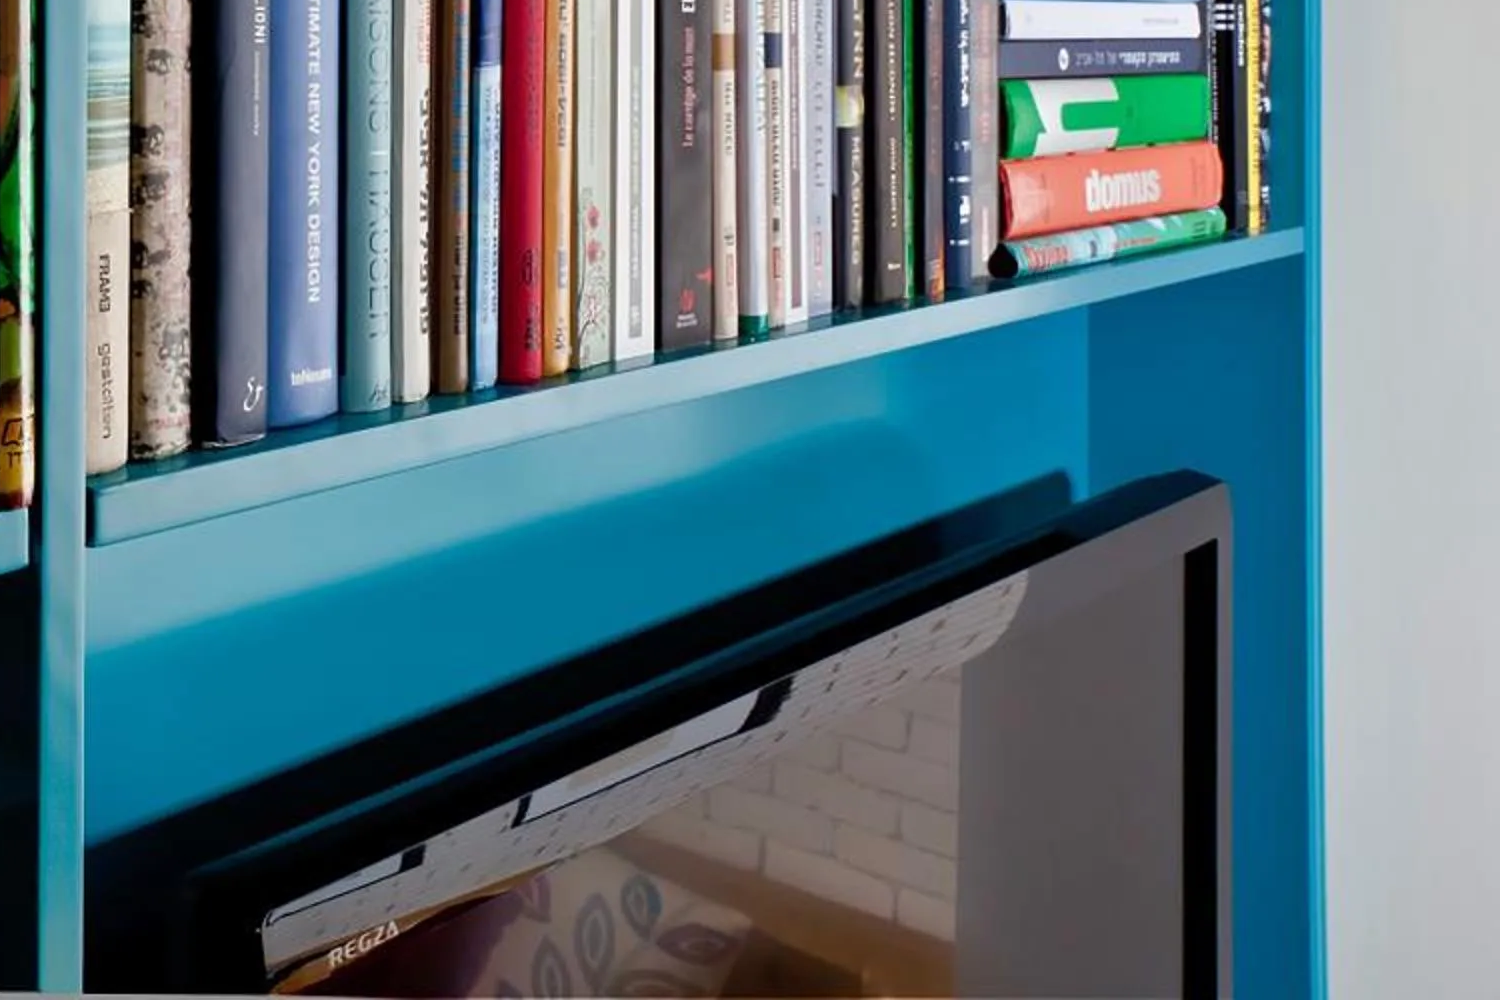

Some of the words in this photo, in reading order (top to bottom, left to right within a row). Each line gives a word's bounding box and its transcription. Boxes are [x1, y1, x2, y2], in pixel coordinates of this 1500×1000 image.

[307, 82, 322, 135] NEW
[307, 142, 322, 207] YORK
[850, 136, 862, 265] MEASURES
[1085, 168, 1162, 213] domus
[306, 213, 321, 303] DESIGN
[96, 342, 116, 441] gestalten
[326, 920, 400, 970] REGZA
